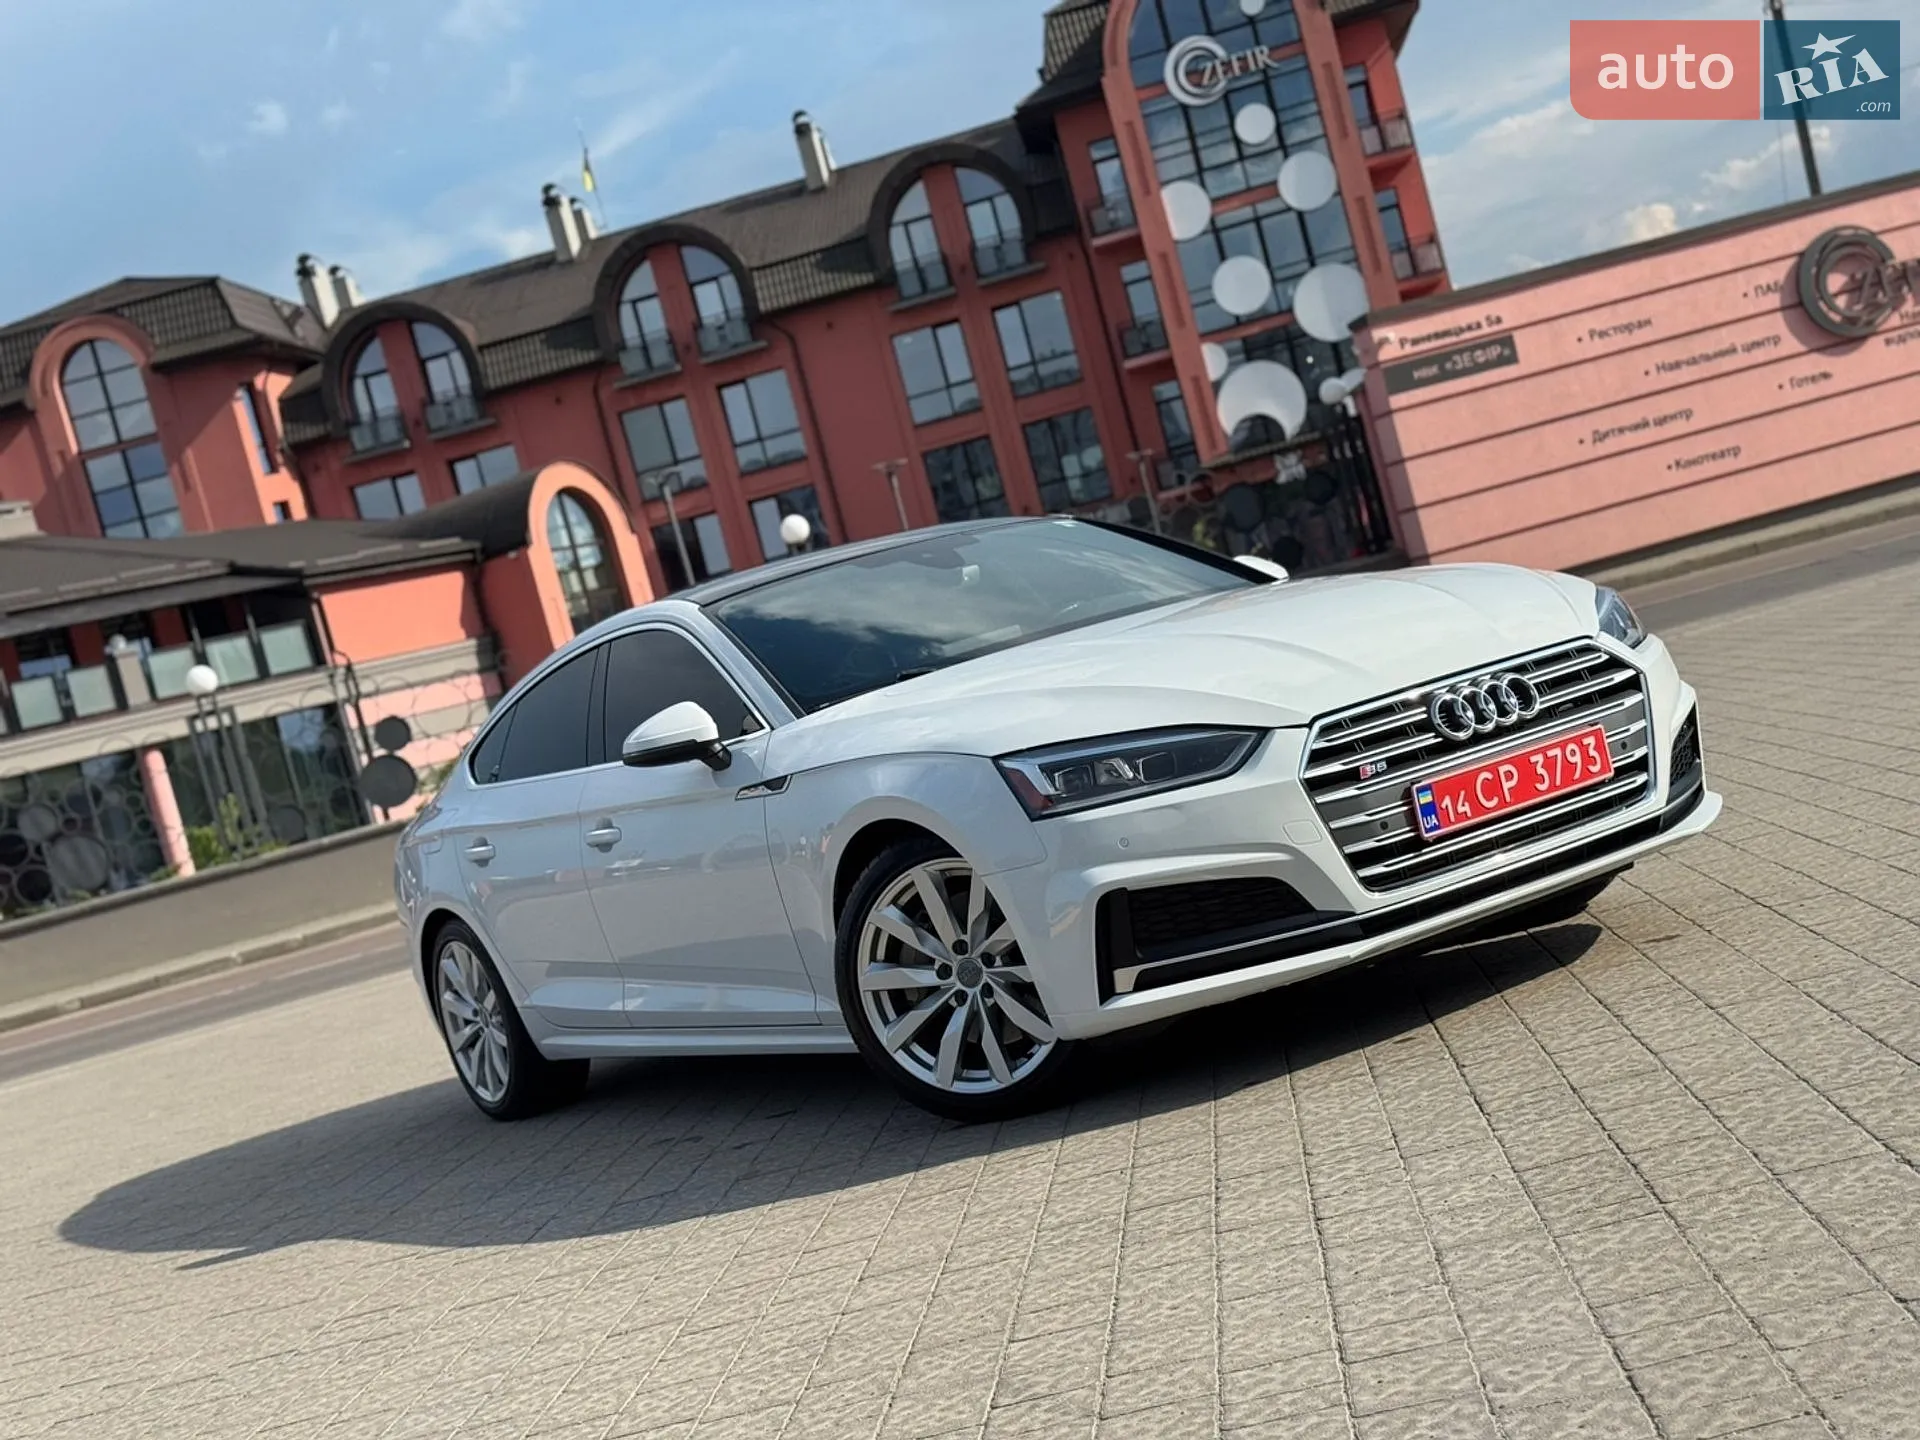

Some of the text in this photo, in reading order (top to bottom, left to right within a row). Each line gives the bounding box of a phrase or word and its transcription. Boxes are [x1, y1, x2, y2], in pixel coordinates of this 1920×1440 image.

[1588, 317, 1653, 342] Ресторан
[1655, 333, 1782, 375] Навчальний центр
[1788, 370, 1833, 390] Готель
[1591, 406, 1694, 446] Дитячий центр
[1674, 444, 1742, 472] Кінотеатр
[1440, 735, 1602, 824] 14 CP 3793
[1423, 814, 1439, 829] UA
